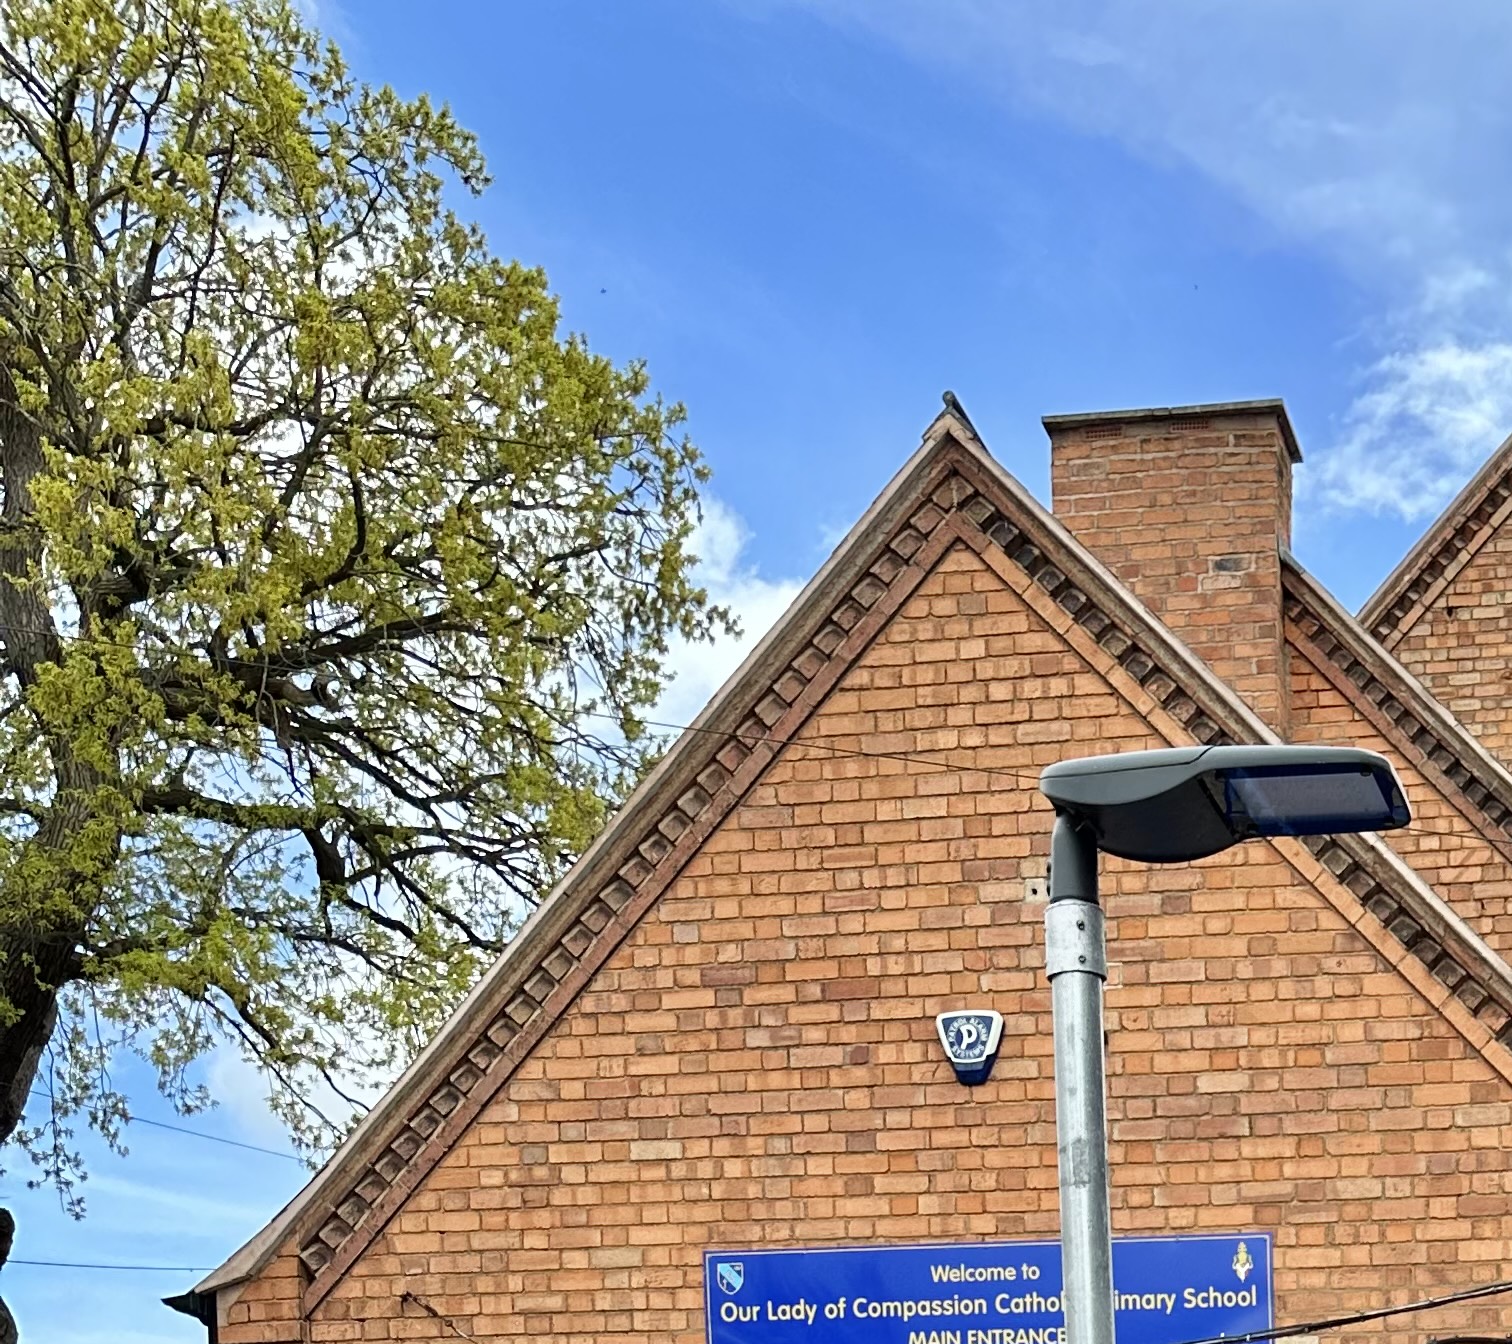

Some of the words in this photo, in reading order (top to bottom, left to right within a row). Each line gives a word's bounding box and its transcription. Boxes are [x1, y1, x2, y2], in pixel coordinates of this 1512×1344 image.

[930, 1263, 1017, 1283] Welcome
[1021, 1262, 1040, 1280] to
[720, 1302, 760, 1322] Our
[767, 1298, 817, 1325] Lady
[824, 1297, 847, 1319] of
[852, 1295, 987, 1321] Compassion
[995, 1291, 1066, 1314] Cathol
[1115, 1290, 1176, 1315] imary
[1183, 1284, 1257, 1309] School
